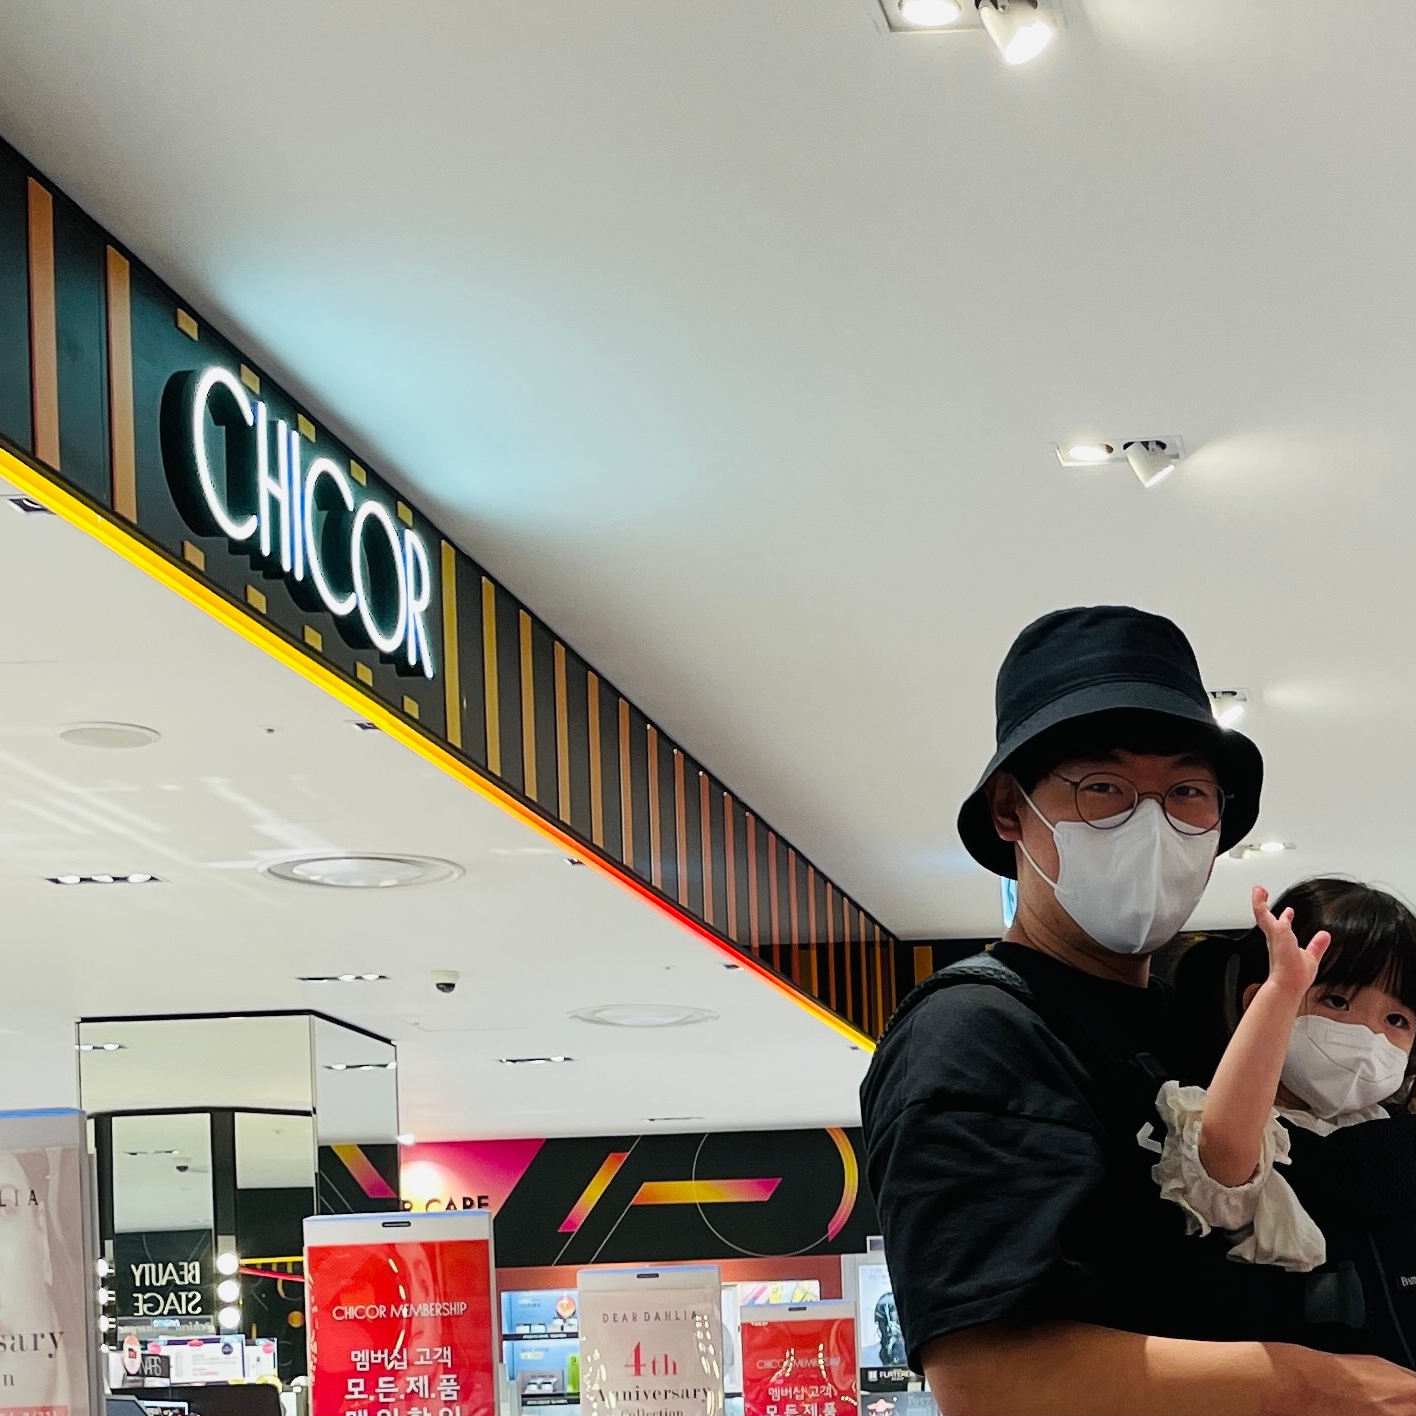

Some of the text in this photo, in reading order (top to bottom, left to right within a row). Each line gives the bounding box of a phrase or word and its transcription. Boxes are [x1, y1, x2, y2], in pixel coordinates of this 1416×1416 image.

[193, 365, 434, 680] CHICOR
[332, 1305, 387, 1321] CHICOR
[602, 1310, 697, 1323] DEAR DAHLIA
[351, 1346, 451, 1371] 멤버십 고객
[624, 1341, 678, 1377] 4th
[599, 1386, 712, 1403] Anniversary
